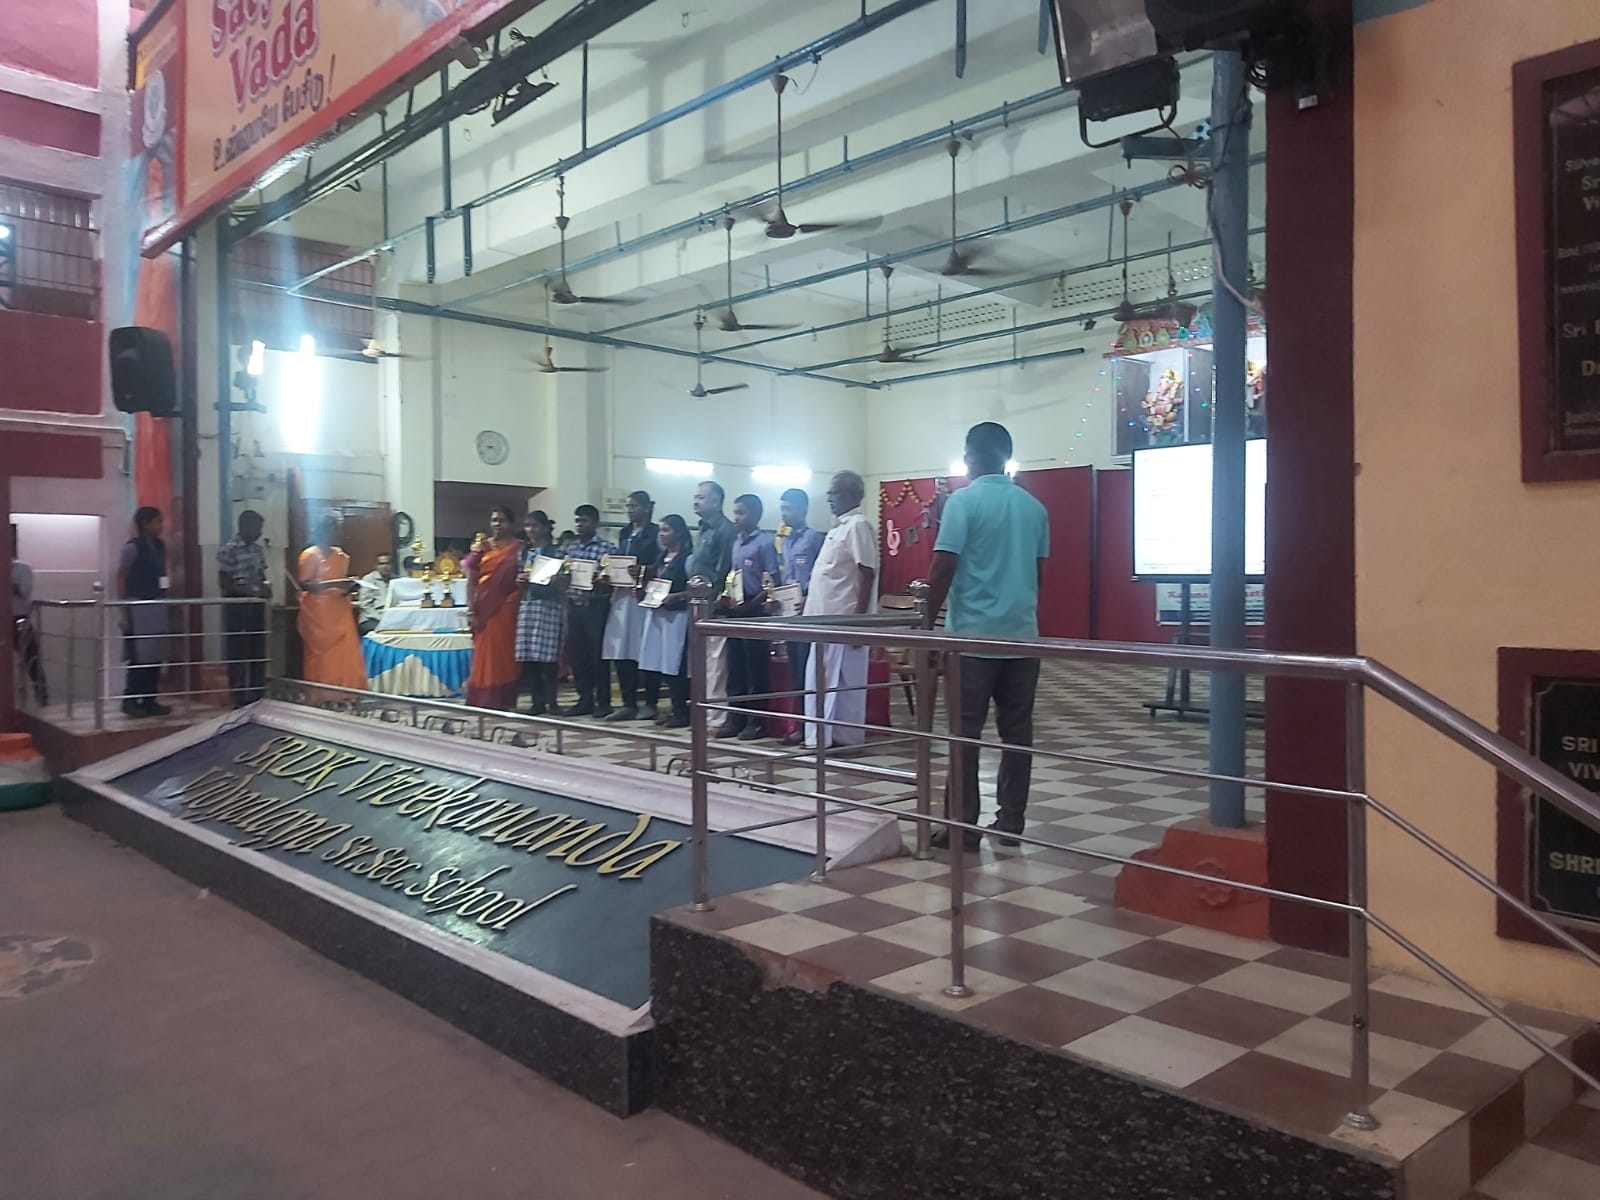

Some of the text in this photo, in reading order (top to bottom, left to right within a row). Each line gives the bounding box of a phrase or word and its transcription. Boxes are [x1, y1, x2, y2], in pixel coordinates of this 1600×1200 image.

[228, 0, 317, 106] Vada
[1561, 735, 1598, 753] SRI
[232, 735, 683, 880] SRDK Vivekananda
